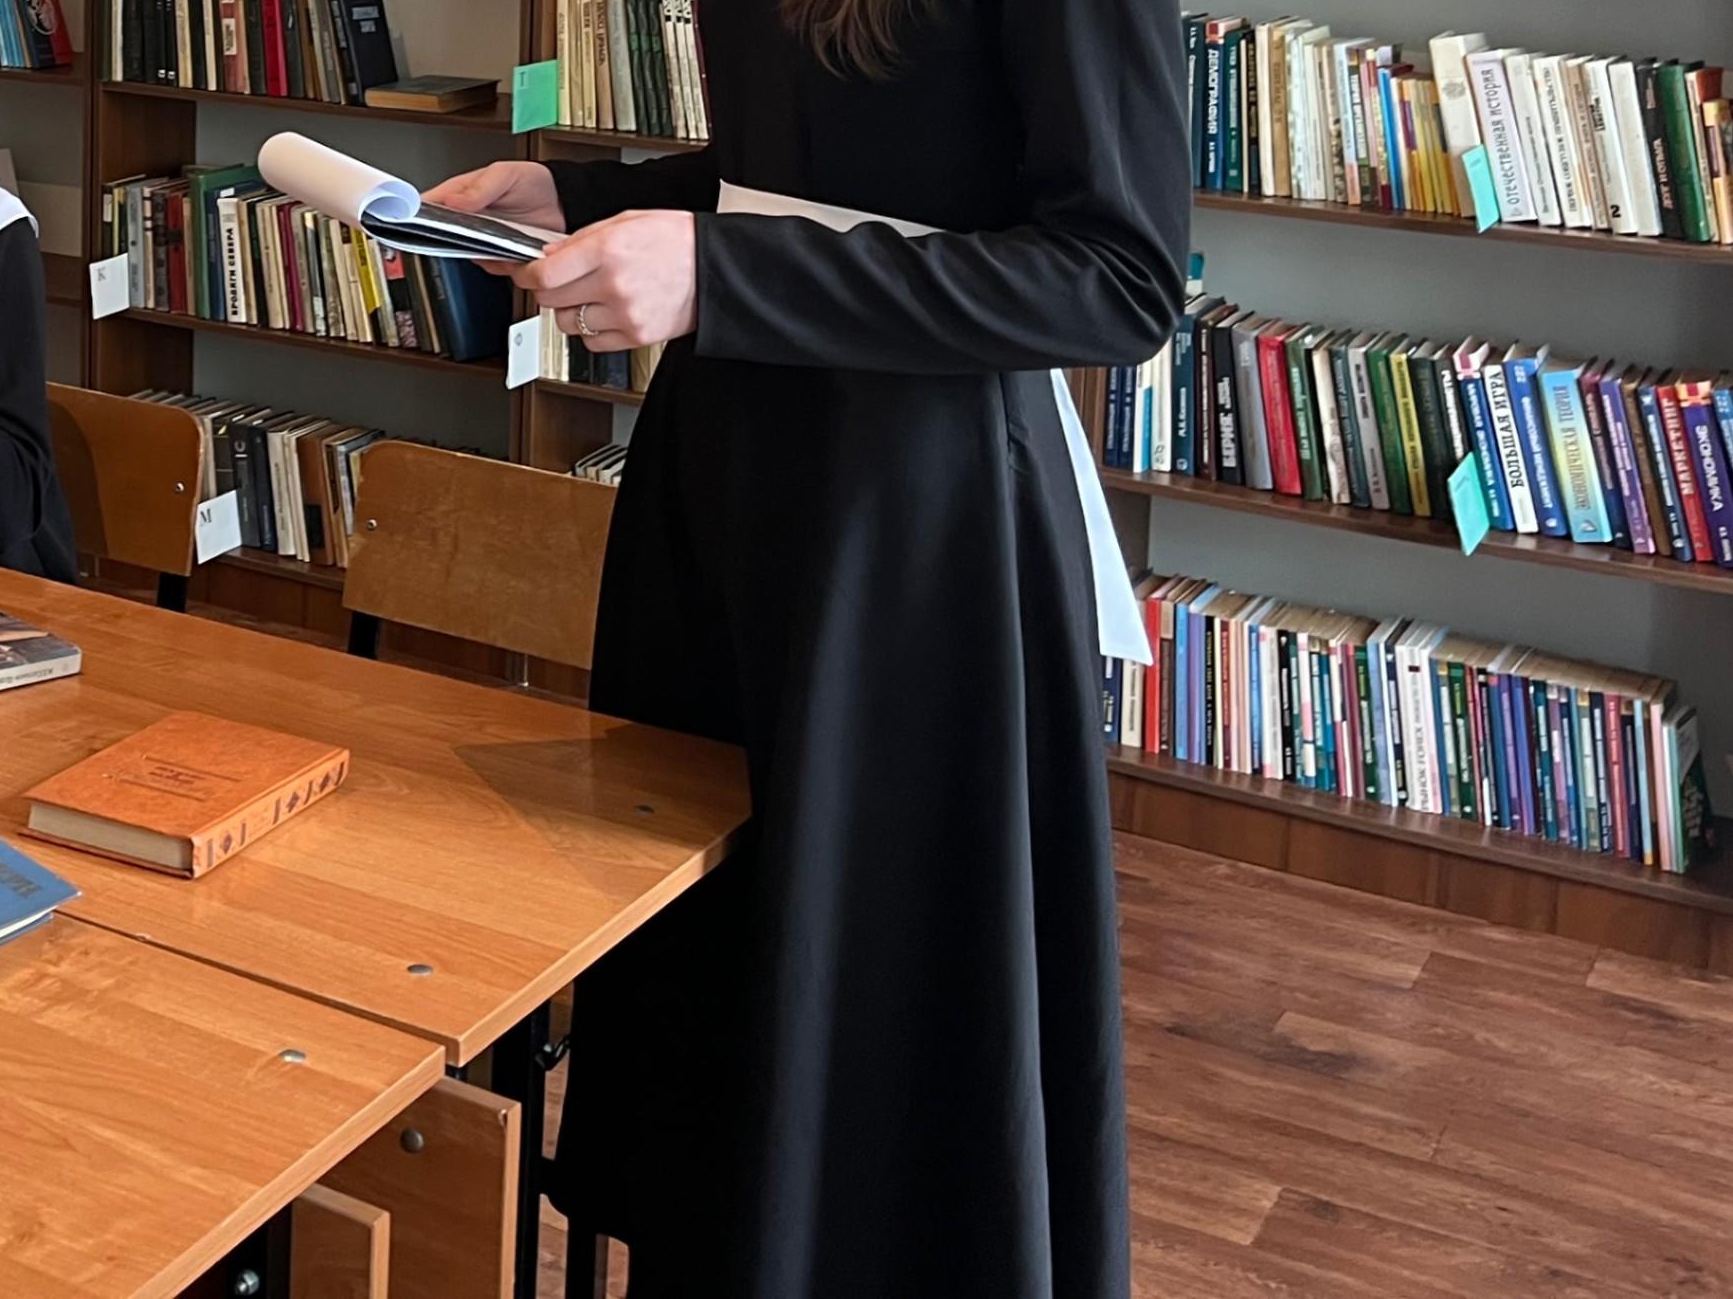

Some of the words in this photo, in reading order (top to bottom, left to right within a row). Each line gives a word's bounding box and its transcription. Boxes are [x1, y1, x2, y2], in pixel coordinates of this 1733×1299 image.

[1207, 49, 1219, 134] ДЕМОГРАФИЯ
[1479, 68, 1501, 116] история
[1492, 119, 1521, 205] отечественная
[225, 227, 236, 266] СЕВЕРА
[1610, 204, 1621, 218] 2
[1489, 370, 1509, 409] ИГРА
[1552, 385, 1574, 422] ТЕОРИЯ
[1476, 430, 1496, 485] ЭКОНОМИКА
[1497, 415, 1524, 488] БОЛЬШАЯ
[1522, 396, 1541, 451] ФИНАНСОВЫЙ
[1533, 453, 1553, 509] МЕНЕДЖМЕНТ
[1560, 427, 1591, 510] ЭКОНОМИЧЕСКАЯ
[1661, 397, 1694, 495] МАРКЕТИНГ
[1695, 425, 1725, 511] ЭКОНОМИКА
